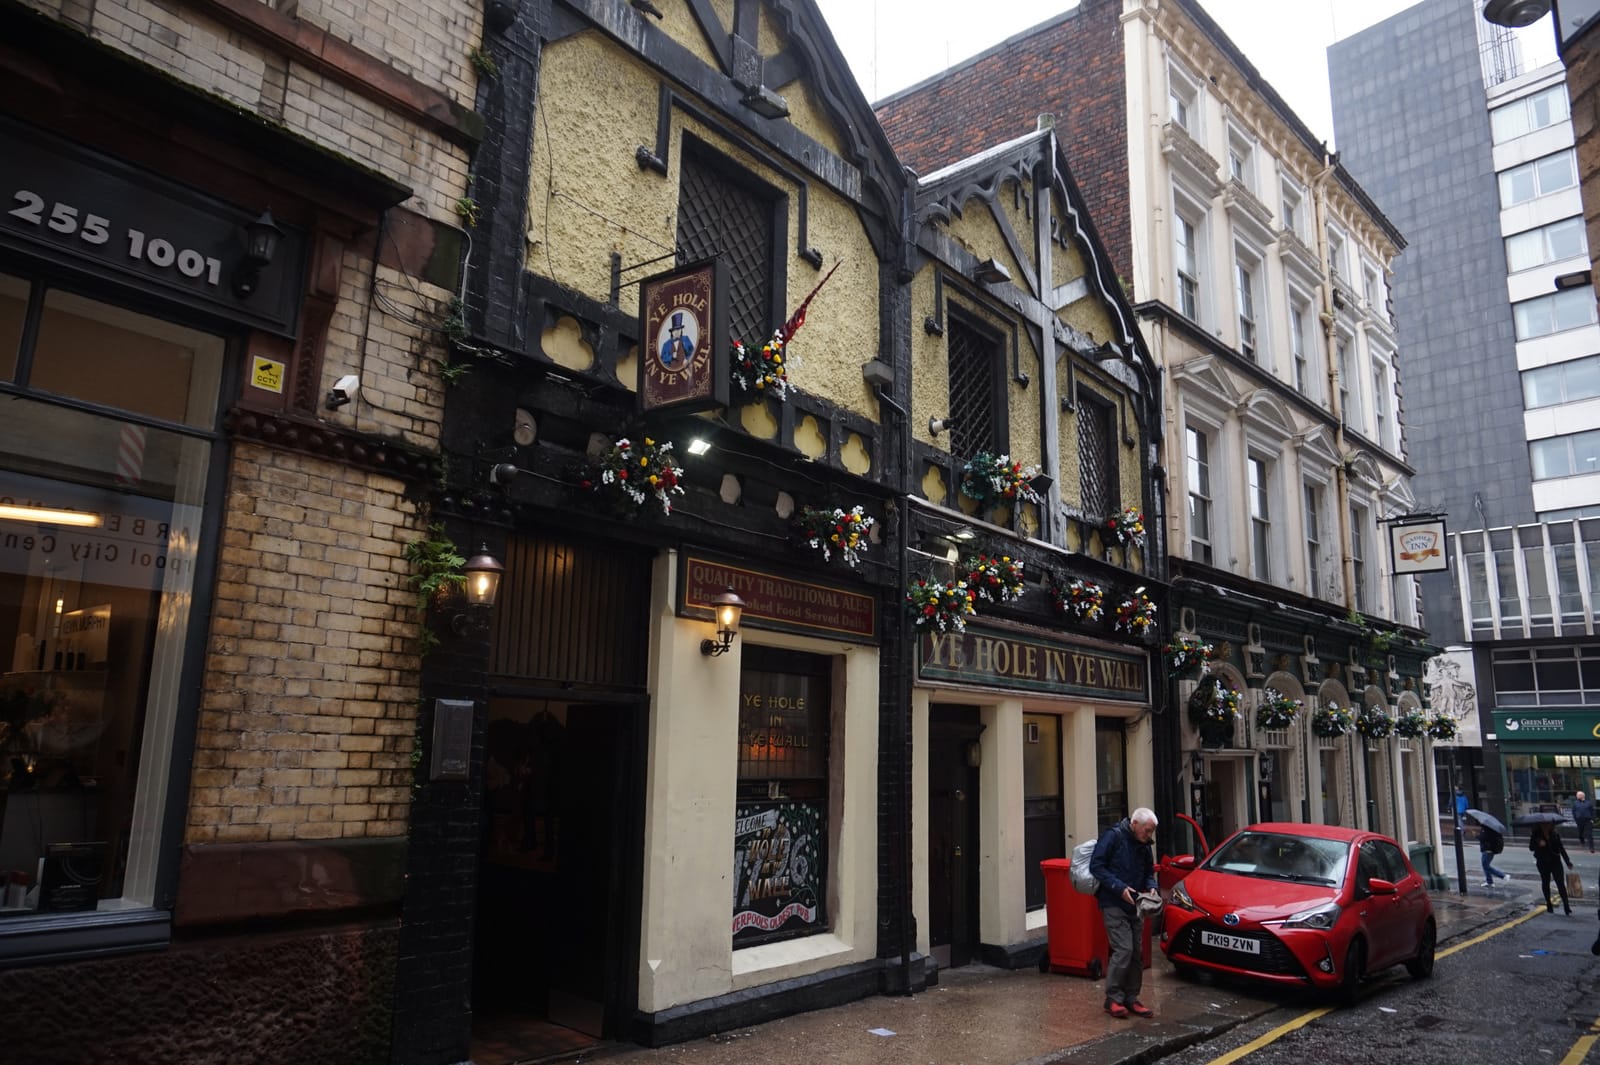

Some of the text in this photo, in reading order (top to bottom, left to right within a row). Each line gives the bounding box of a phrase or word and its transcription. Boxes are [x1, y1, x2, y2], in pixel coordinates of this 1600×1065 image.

[8, 190, 222, 286] 255 1001
[650, 292, 707, 323] YE HOLE
[645, 344, 711, 386] IN YE WALL
[256, 374, 279, 386] CCTV
[1411, 542, 1428, 551] INN
[693, 565, 870, 613] QUALITY TRADITIONAL ALES
[693, 587, 866, 630] Hom oked Food Served Daily
[930, 631, 1142, 691] YE HOLE IN YE WALL
[770, 714, 783, 727] IN
[749, 838, 790, 864] HOLE
[748, 876, 790, 900] WALL
[796, 904, 810, 921] PUB
[1207, 934, 1253, 951] PK19 ZVN
